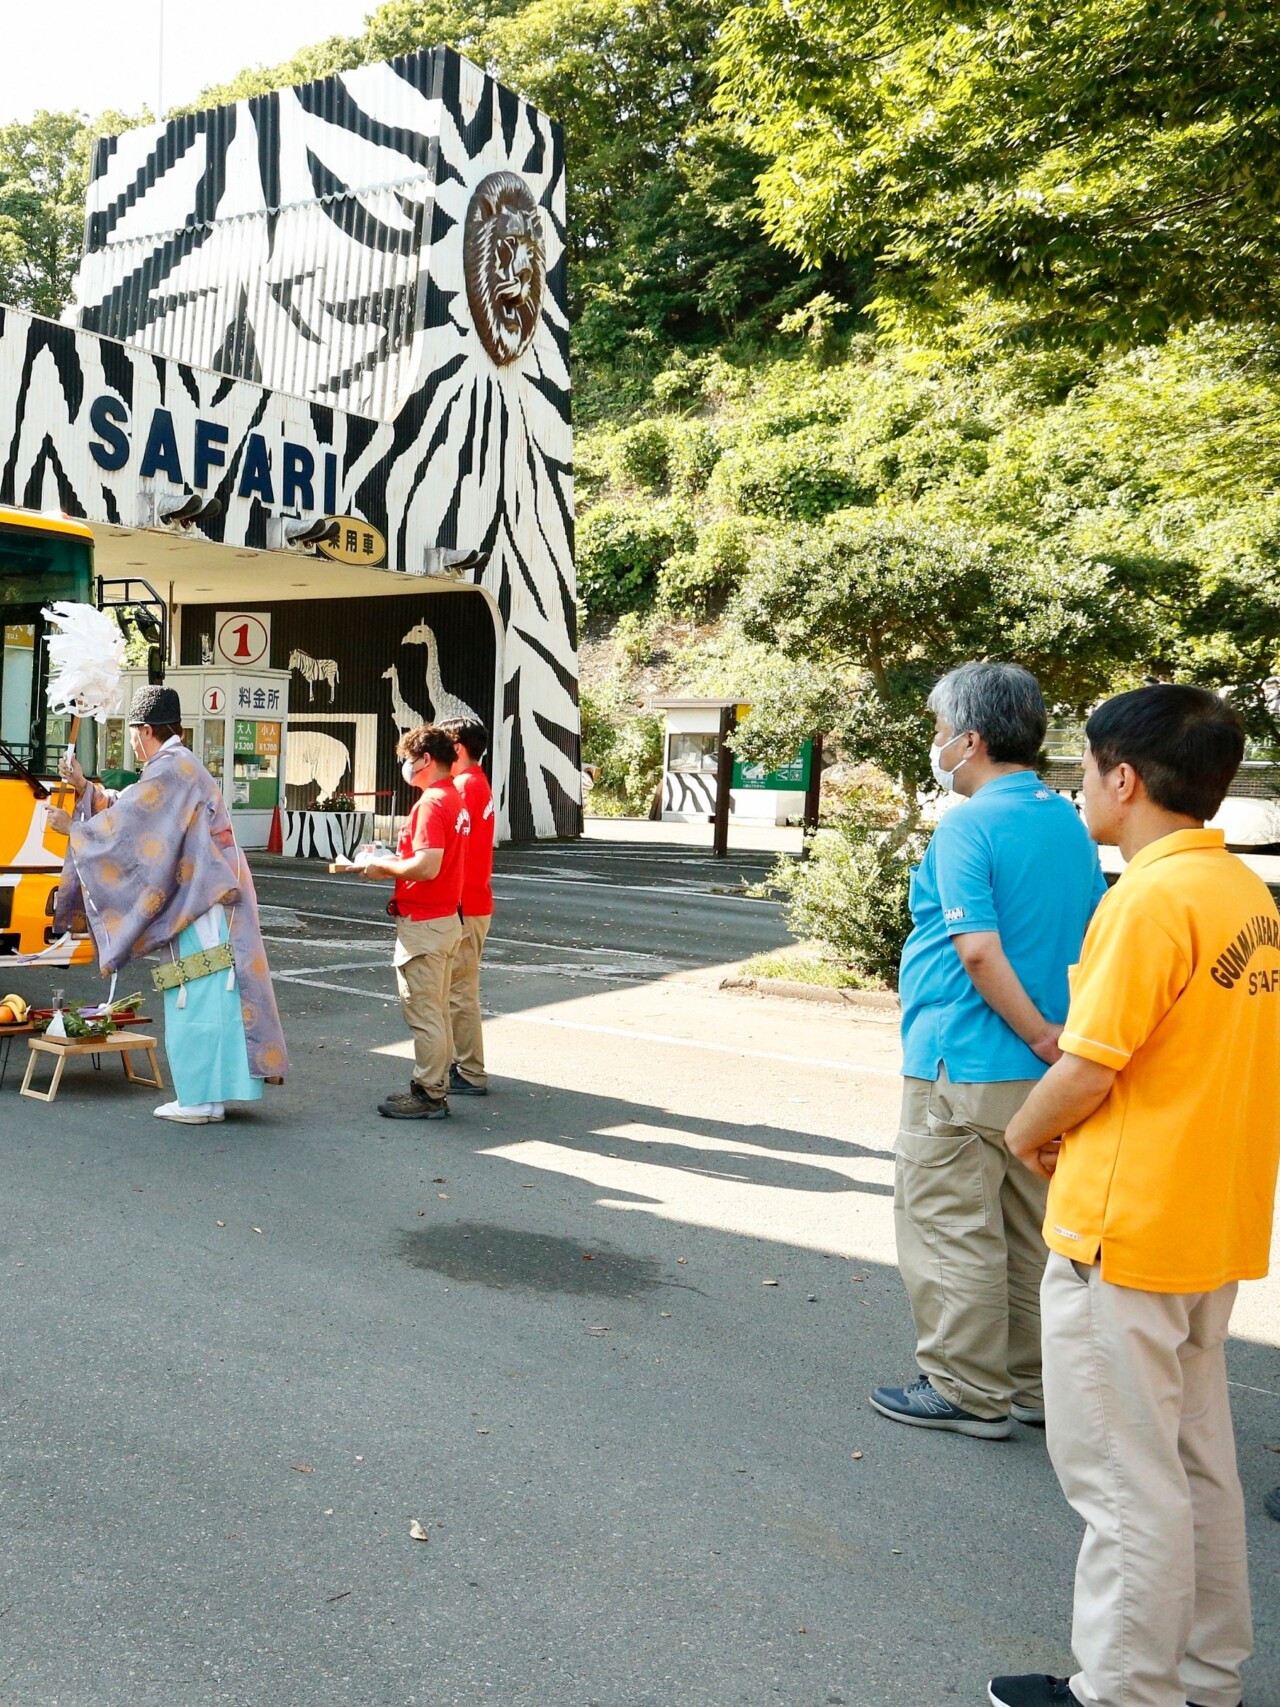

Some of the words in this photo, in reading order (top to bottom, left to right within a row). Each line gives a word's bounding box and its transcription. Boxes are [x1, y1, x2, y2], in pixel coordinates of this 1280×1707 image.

[89, 395, 337, 515] SAFARI
[232, 623, 251, 656] 1
[209, 691, 218, 710] 1
[238, 686, 280, 710] 料金所
[236, 723, 252, 735] 大人
[261, 724, 276, 736] 小人
[1210, 922, 1256, 989] GUNMA
